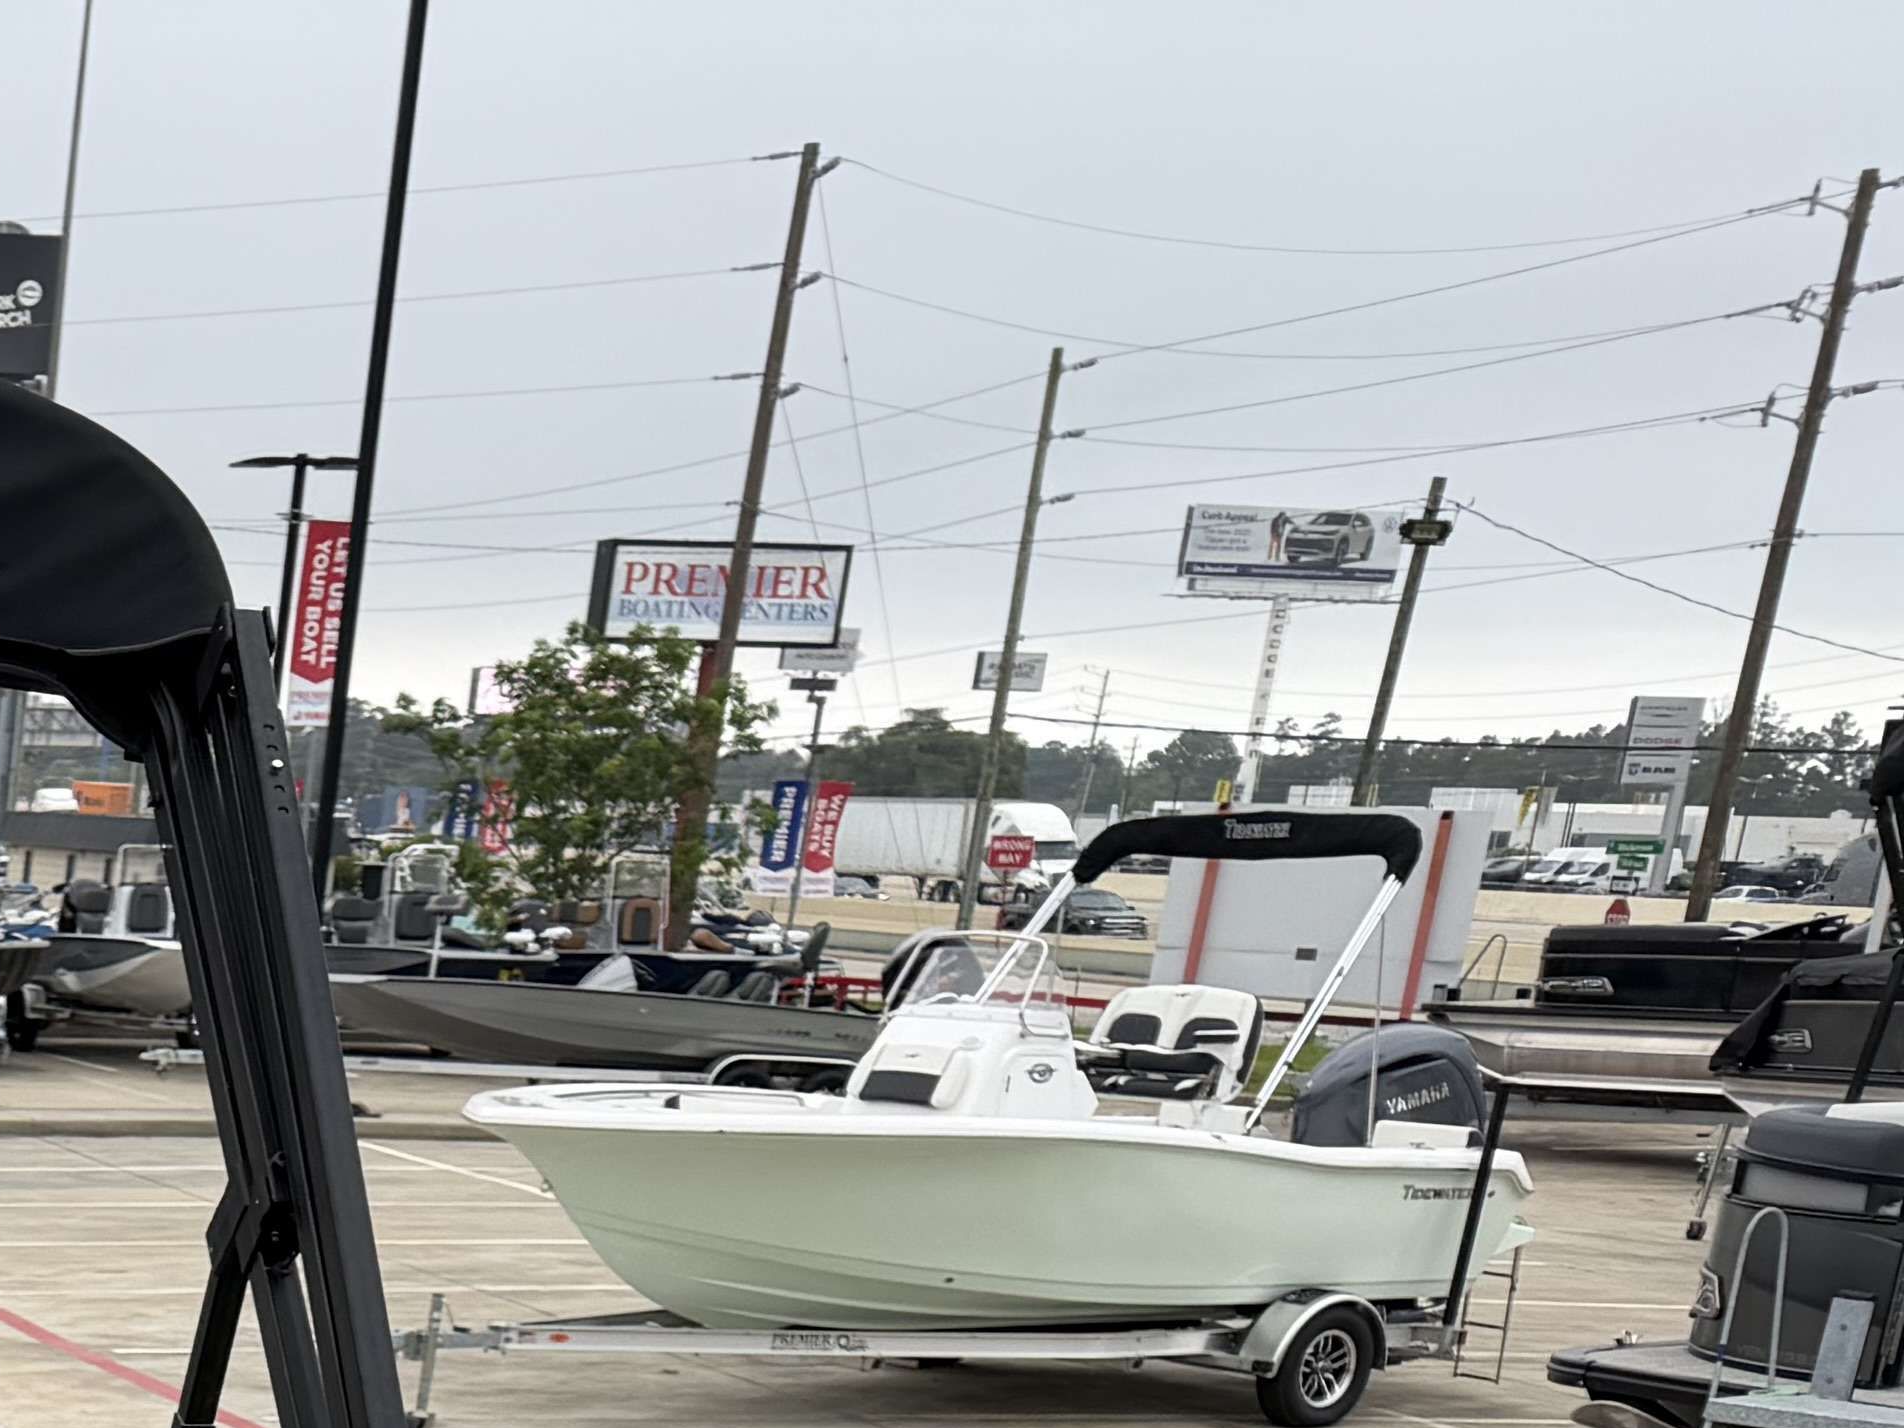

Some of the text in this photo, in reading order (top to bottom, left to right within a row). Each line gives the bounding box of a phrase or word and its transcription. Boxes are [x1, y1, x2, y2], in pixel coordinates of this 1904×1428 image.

[307, 538, 333, 602] YOUR
[320, 536, 350, 669] LET US SELL
[618, 599, 830, 622] BOATING ENTERS
[300, 606, 322, 666] BOAT
[1642, 766, 1676, 774] RAM
[768, 786, 799, 863] PREMIER
[819, 793, 845, 858] WE BUY
[998, 851, 1022, 864] WAY
[1386, 1081, 1450, 1114] YAMAHA
